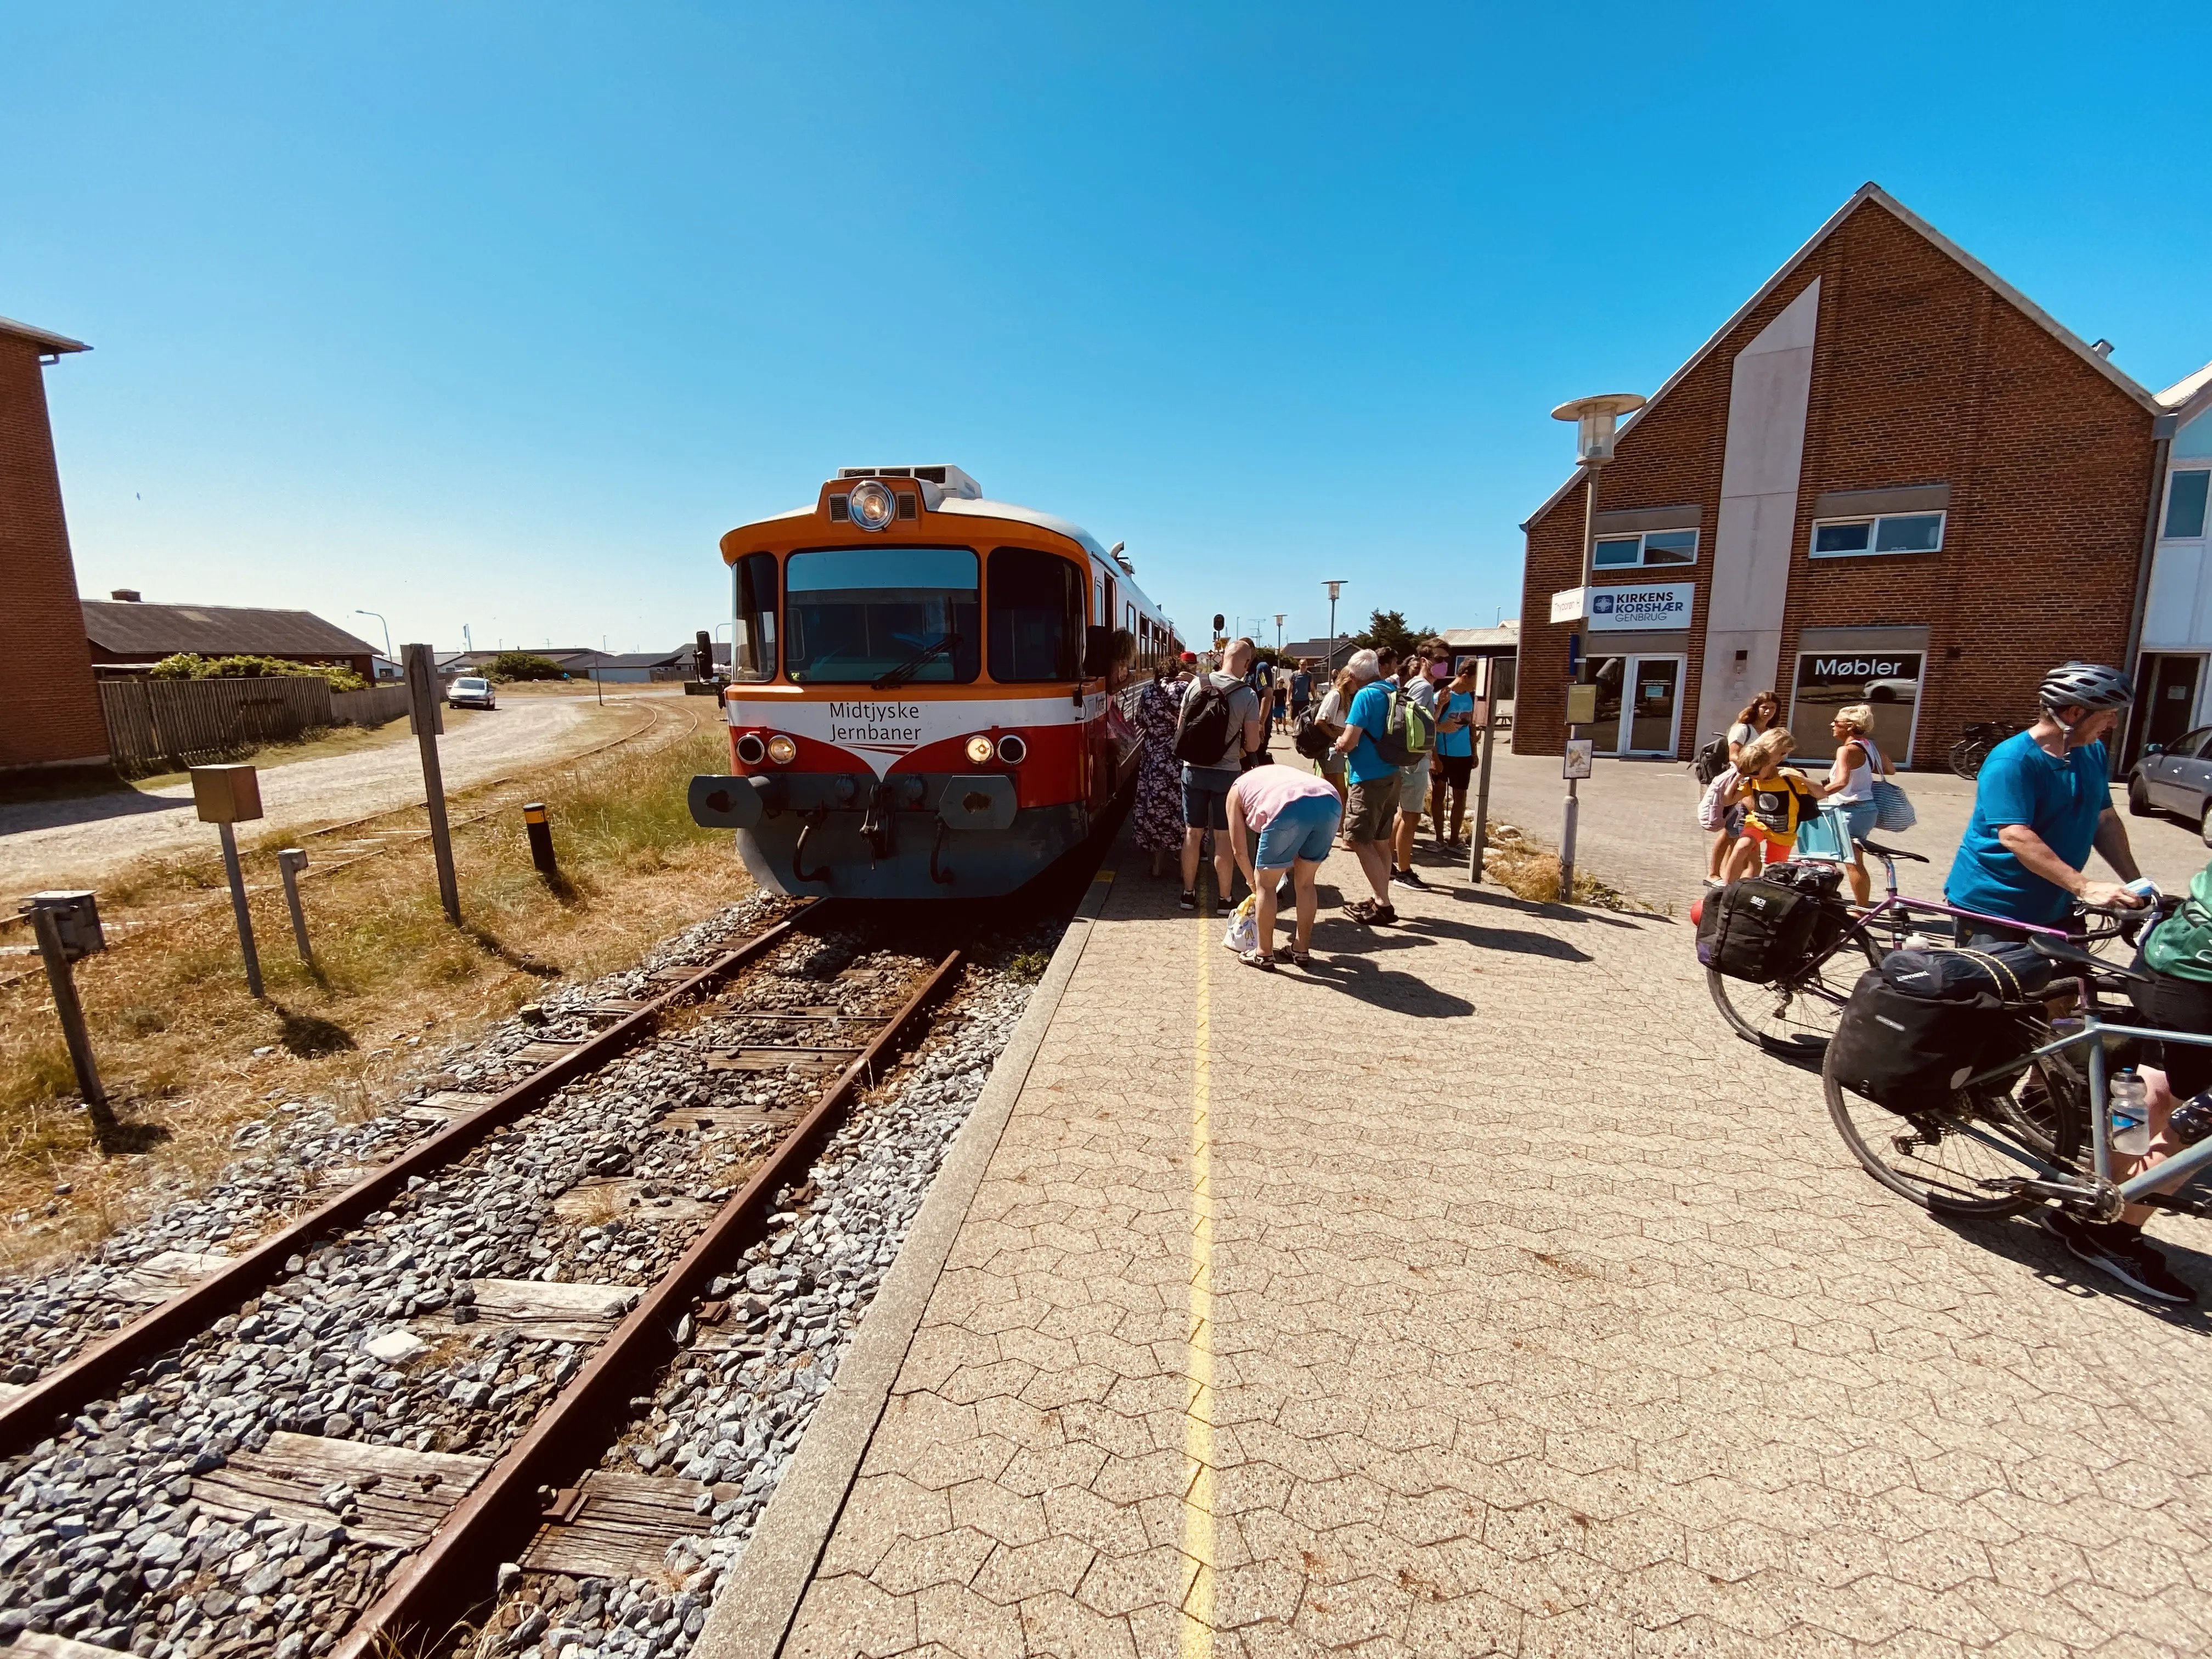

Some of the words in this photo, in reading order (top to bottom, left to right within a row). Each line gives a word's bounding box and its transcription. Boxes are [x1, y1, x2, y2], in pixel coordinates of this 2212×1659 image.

[1617, 591, 1673, 603] KIRKENS
[1616, 602, 1684, 613] KORSHÆR
[1615, 612, 1667, 622] GENBRUG
[1815, 659, 1902, 676] Møbler
[830, 701, 919, 723] Midtjyske
[830, 724, 922, 742] Jernbaner
